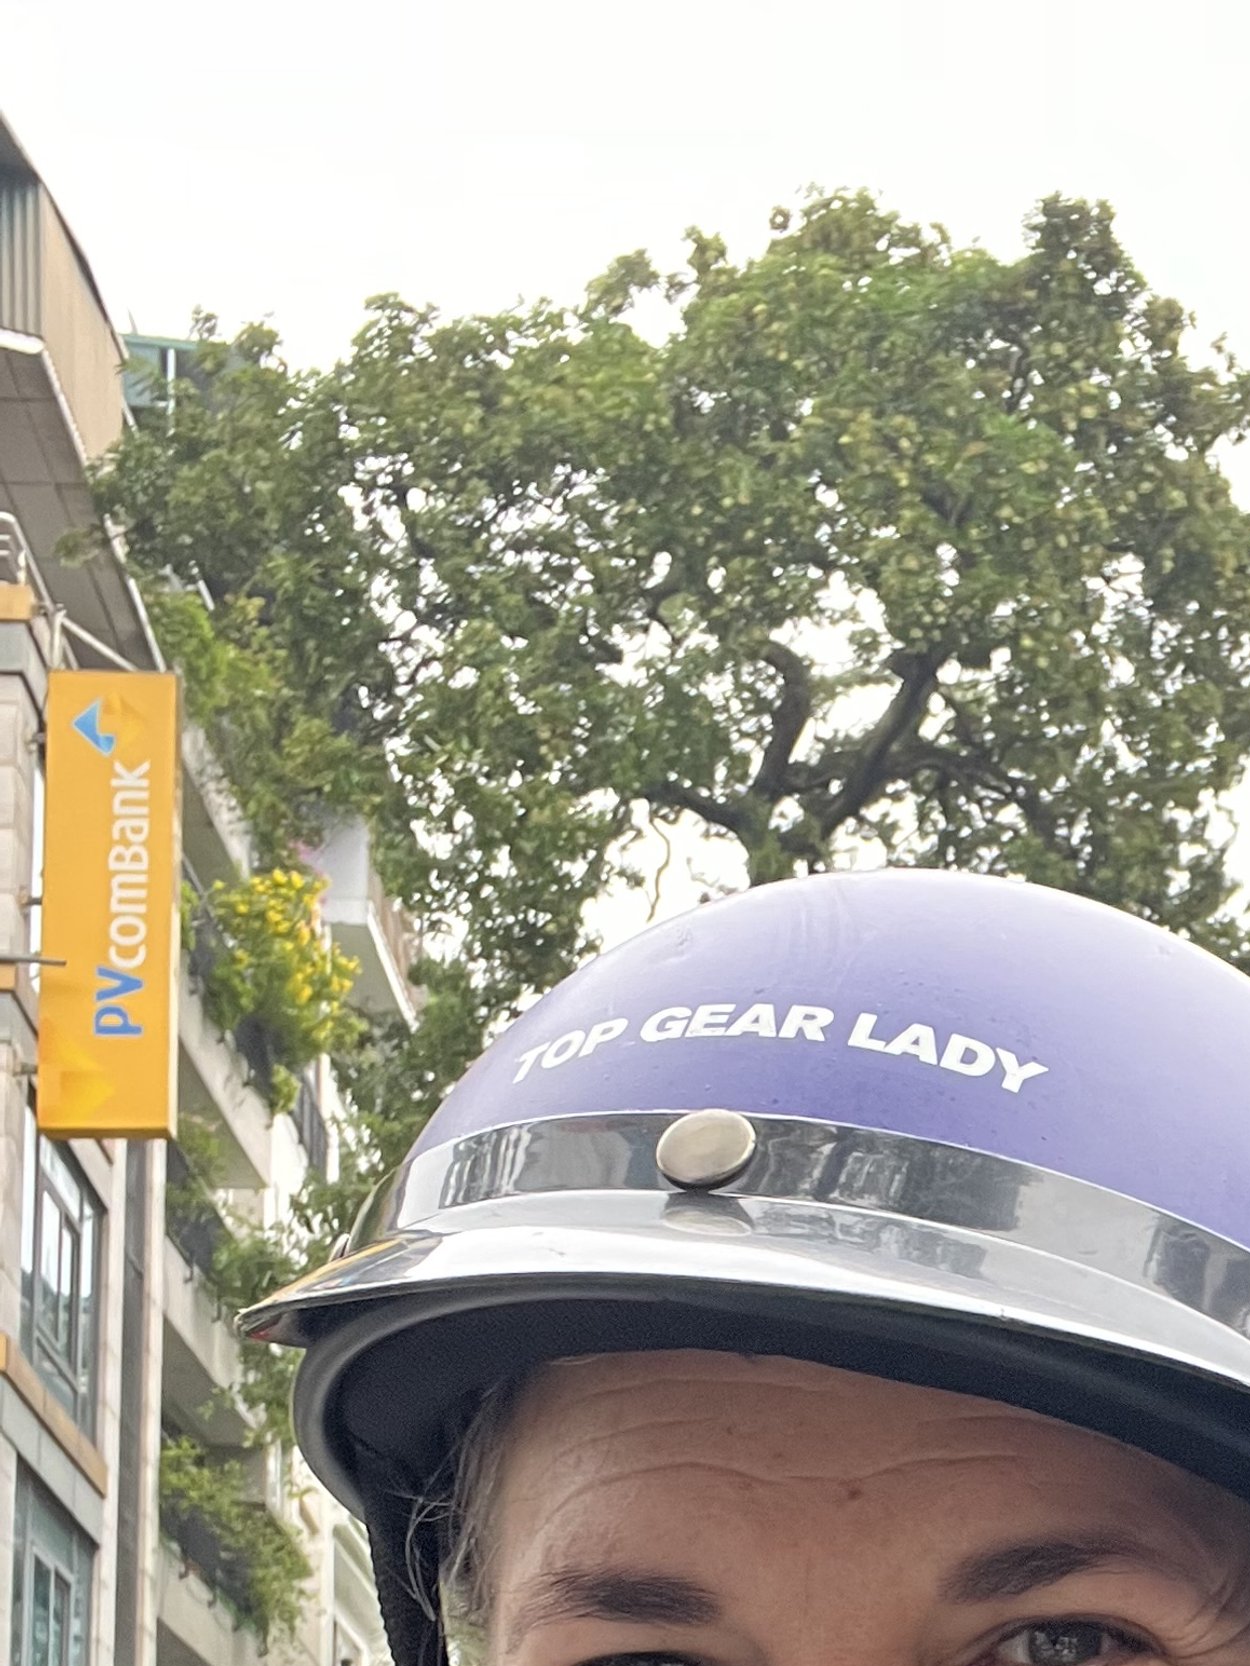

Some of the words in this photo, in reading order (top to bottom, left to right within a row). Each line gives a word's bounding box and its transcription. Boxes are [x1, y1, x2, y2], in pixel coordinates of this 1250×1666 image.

[512, 1018, 628, 1084] TOP
[639, 1004, 834, 1042] GEAR
[847, 1013, 1049, 1094] LADY
